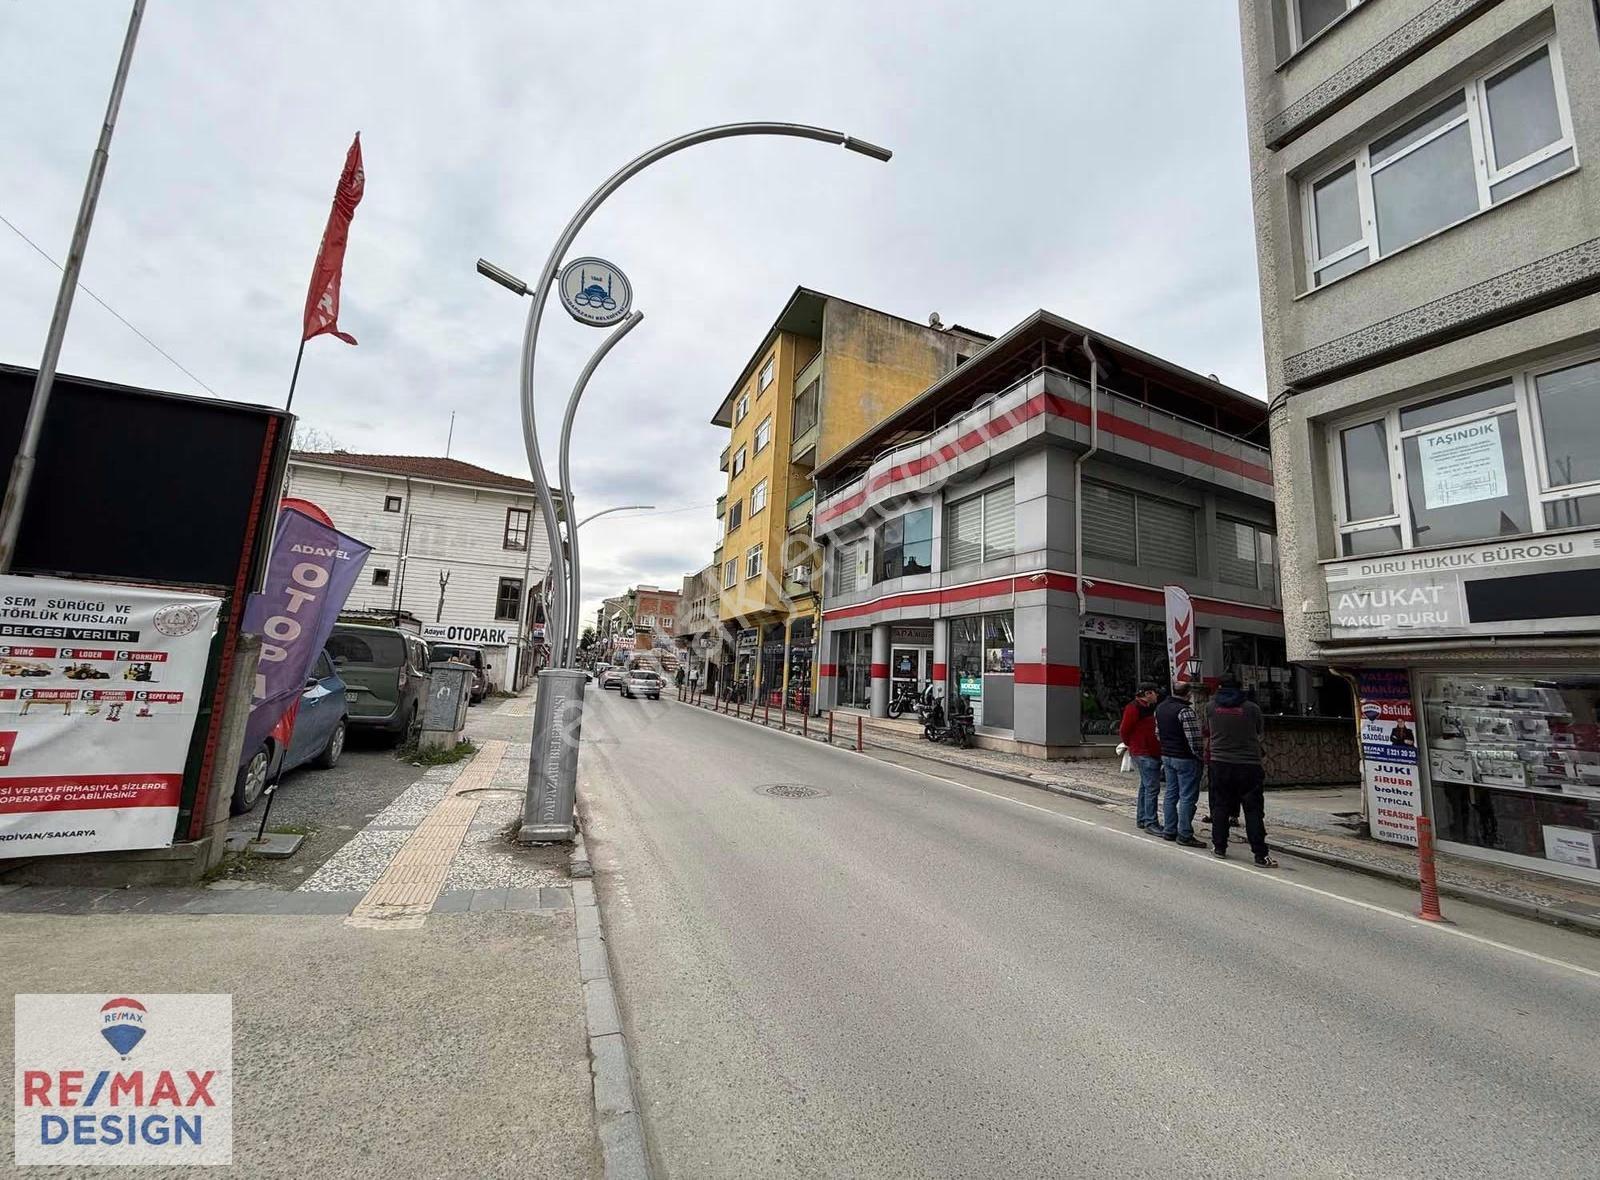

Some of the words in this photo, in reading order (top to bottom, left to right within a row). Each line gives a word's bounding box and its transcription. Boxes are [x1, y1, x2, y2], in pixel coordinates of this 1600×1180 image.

[1423, 421, 1480, 441] TAŞINDIK
[291, 543, 351, 560] ADAYEL
[1361, 561, 1406, 576] DURU
[1411, 553, 1476, 570] HUKUK
[1482, 541, 1574, 563] BÜROSU
[4, 596, 36, 607] SEM
[47, 599, 105, 612] SÜRÜCÜ
[115, 605, 132, 614] VE
[1338, 585, 1445, 610] AVUKAT
[0, 607, 59, 620] TÖRLÜK
[62, 614, 129, 625] KURSLARI
[1337, 613, 1392, 627] YAKUP
[1397, 611, 1448, 625] DURU
[2, 626, 67, 638] BELGESİ
[72, 629, 131, 641] VERİLİR
[447, 626, 506, 643] OTOPARK
[1382, 704, 1412, 716] Satılık
[1374, 765, 1411, 776] JUKI
[15, 786, 54, 795] VEREN
[56, 783, 118, 793] FİRMASIYLA
[121, 782, 169, 790] SİZLERDE
[1374, 785, 1414, 797] brother
[0, 794, 61, 804] OPERATÖR
[64, 791, 138, 801] OLABİLİRSİNİZ
[1376, 796, 1414, 807] TYPICAL
[1377, 808, 1414, 820] PEGASUS
